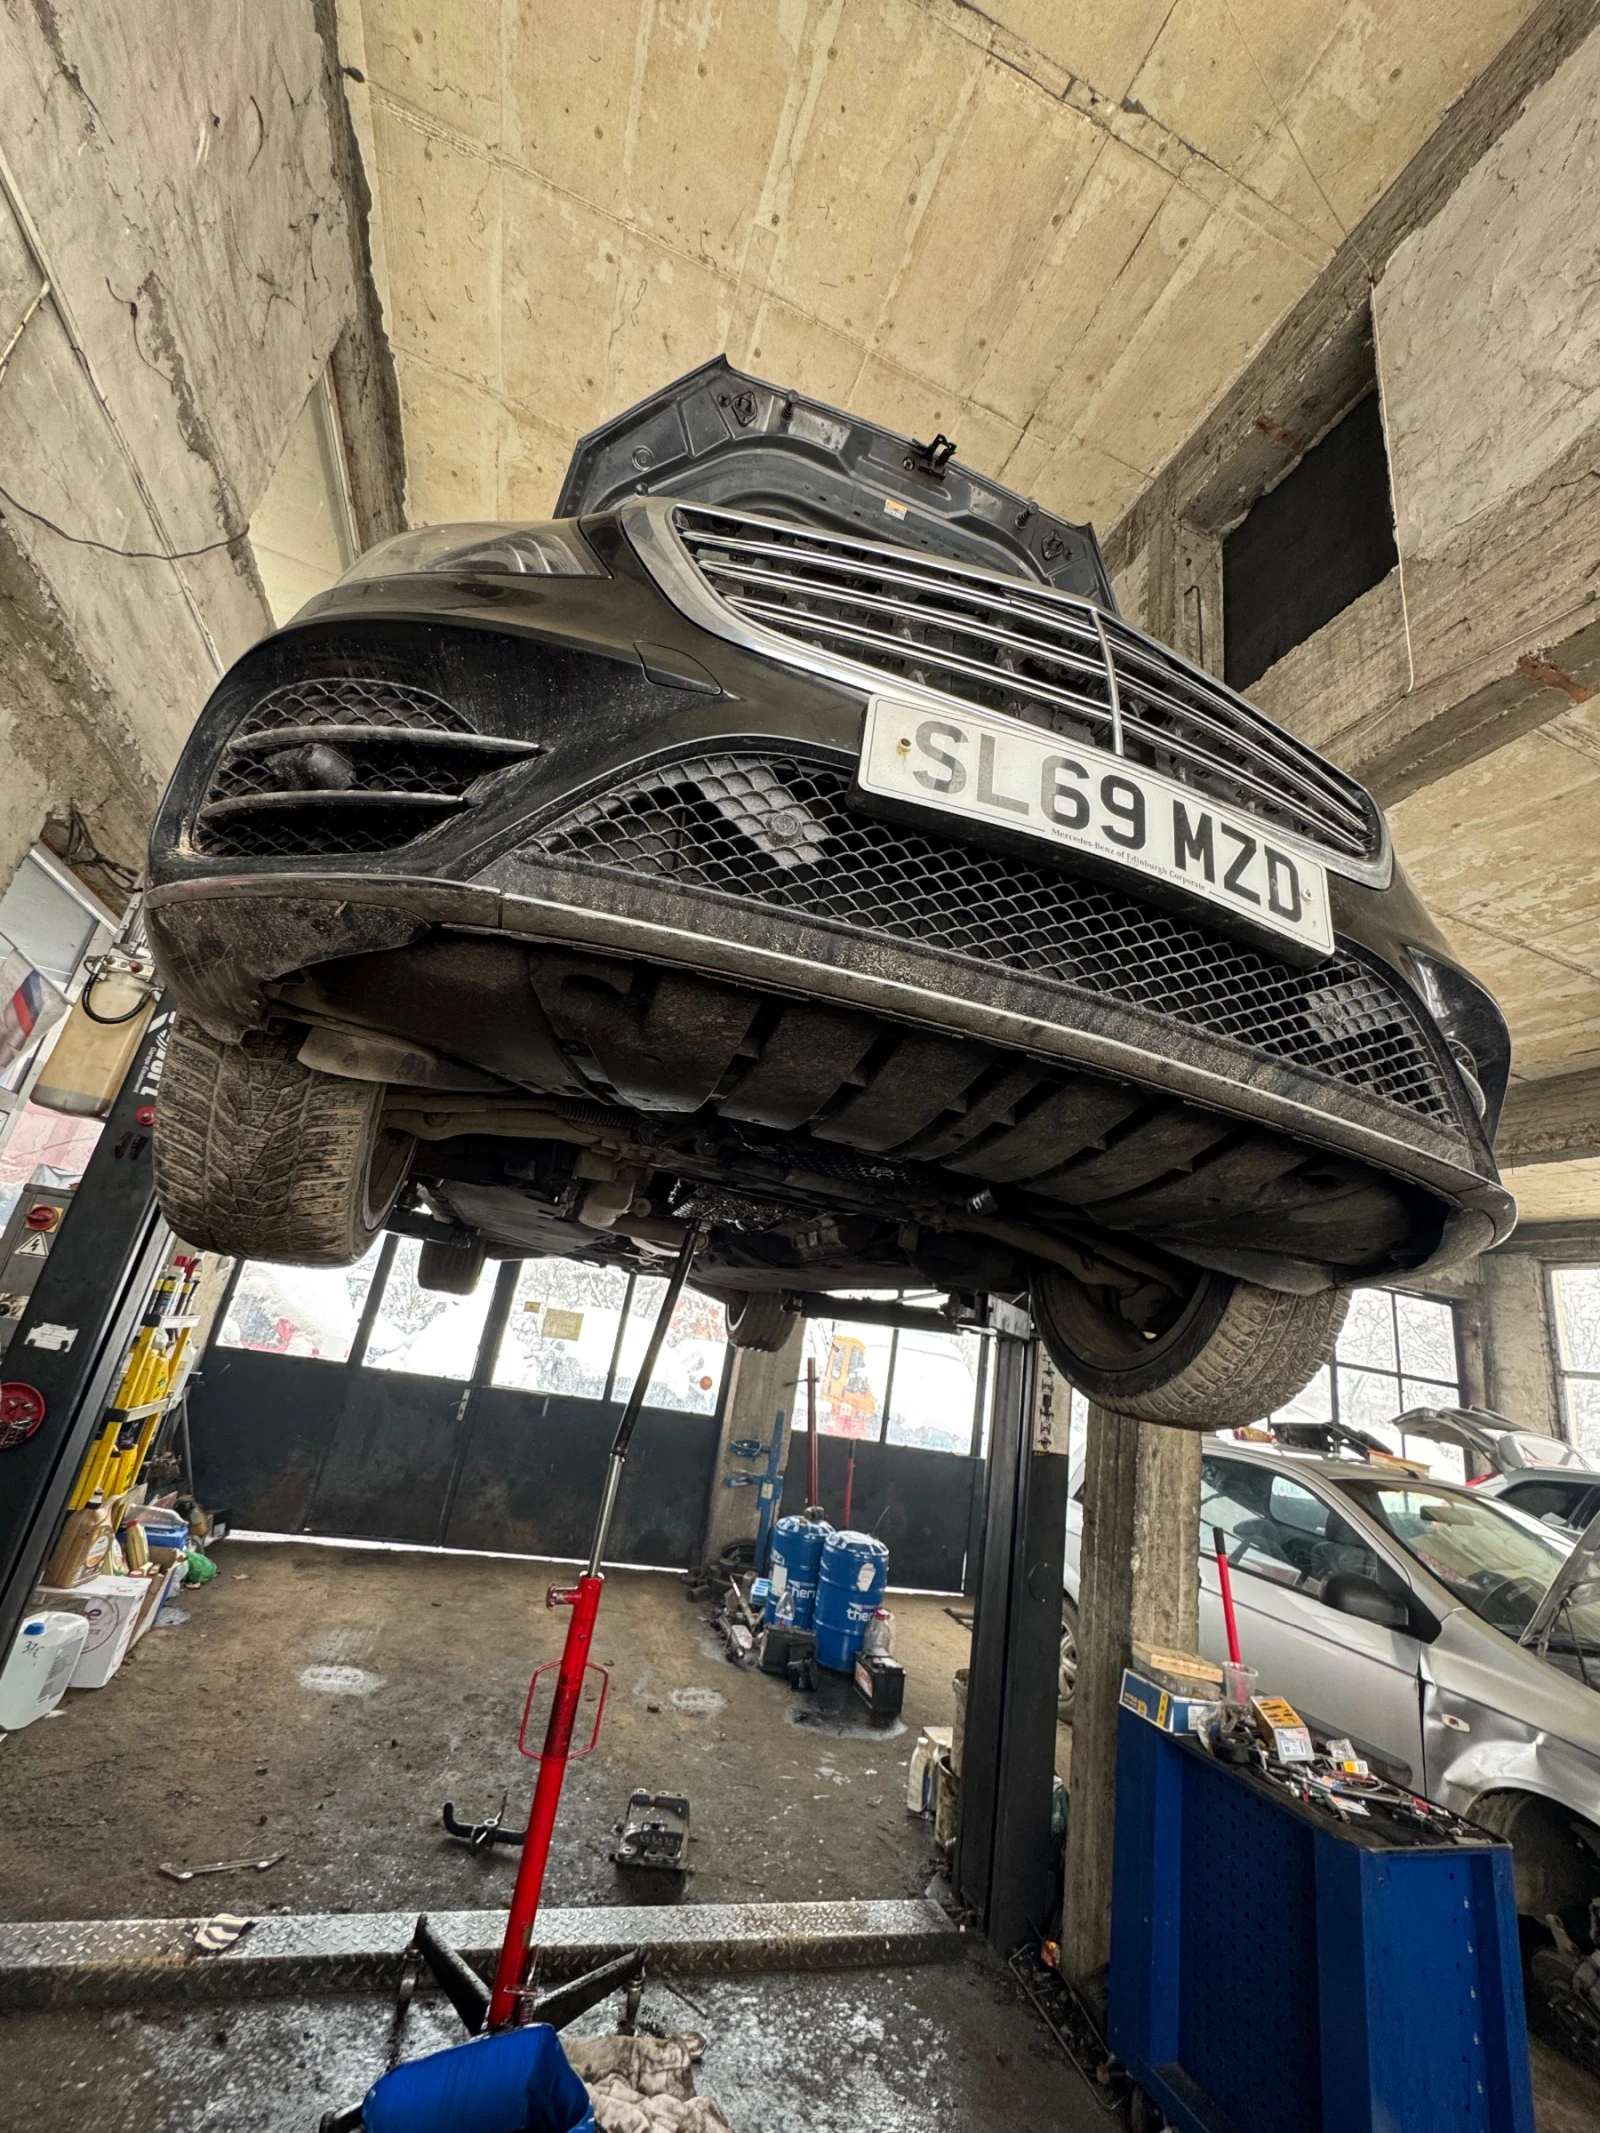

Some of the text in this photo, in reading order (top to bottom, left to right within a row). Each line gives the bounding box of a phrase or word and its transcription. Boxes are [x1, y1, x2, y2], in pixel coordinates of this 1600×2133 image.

[912, 720, 1304, 924] SL69 MZD
[1051, 827, 1206, 890] Mercedes-Benz of Edinburgh Corporate
